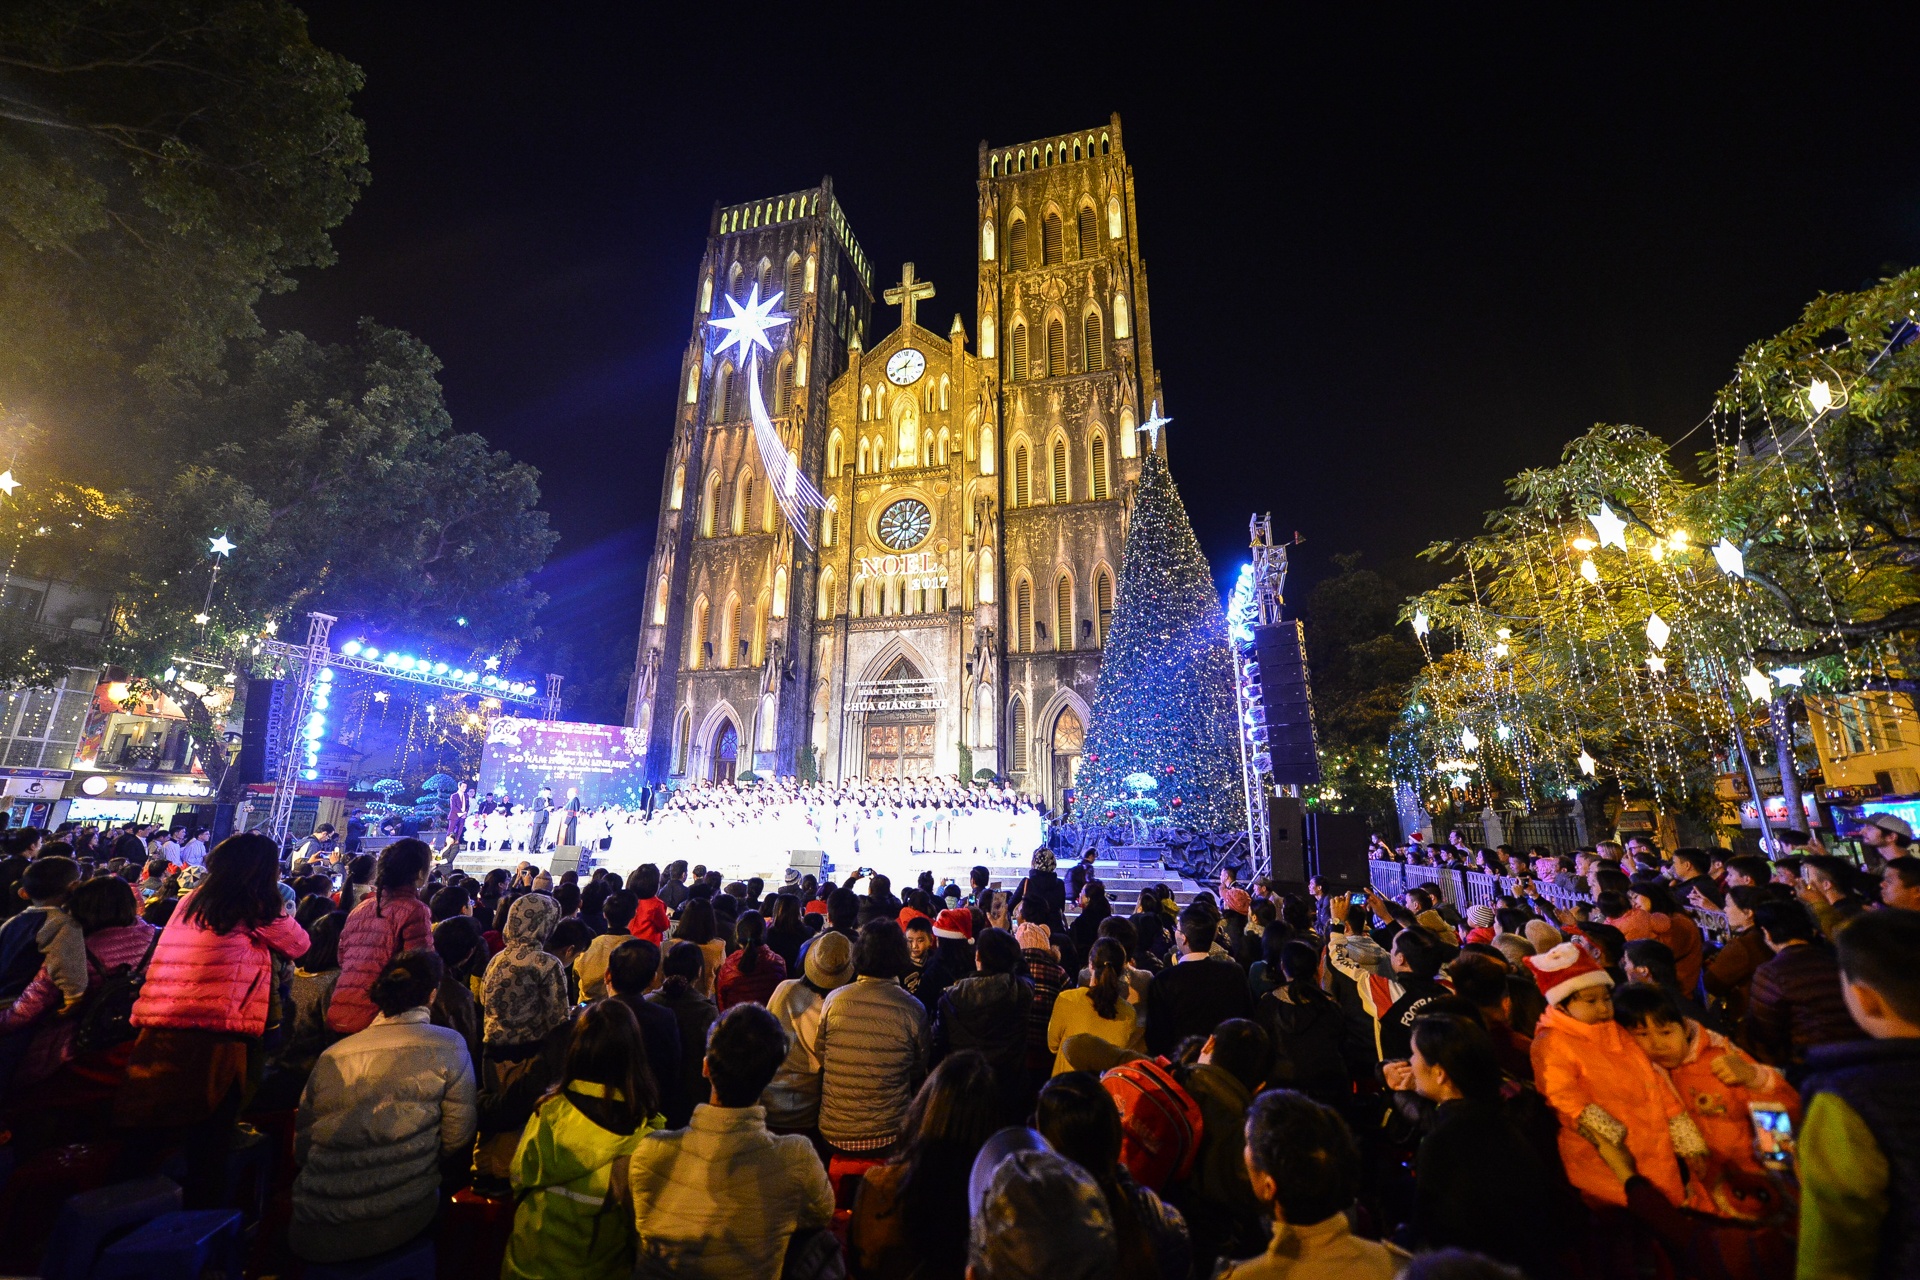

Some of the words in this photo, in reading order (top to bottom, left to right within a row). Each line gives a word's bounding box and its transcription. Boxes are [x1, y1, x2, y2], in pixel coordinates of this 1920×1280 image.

[860, 552, 938, 578] NOEL
[911, 576, 948, 590] 2017
[878, 698, 917, 710] GIÁNG
[920, 699, 948, 709] SINH
[507, 753, 524, 763] 50
[114, 781, 149, 794] THE
[1400, 997, 1437, 1027] FOOTBA
